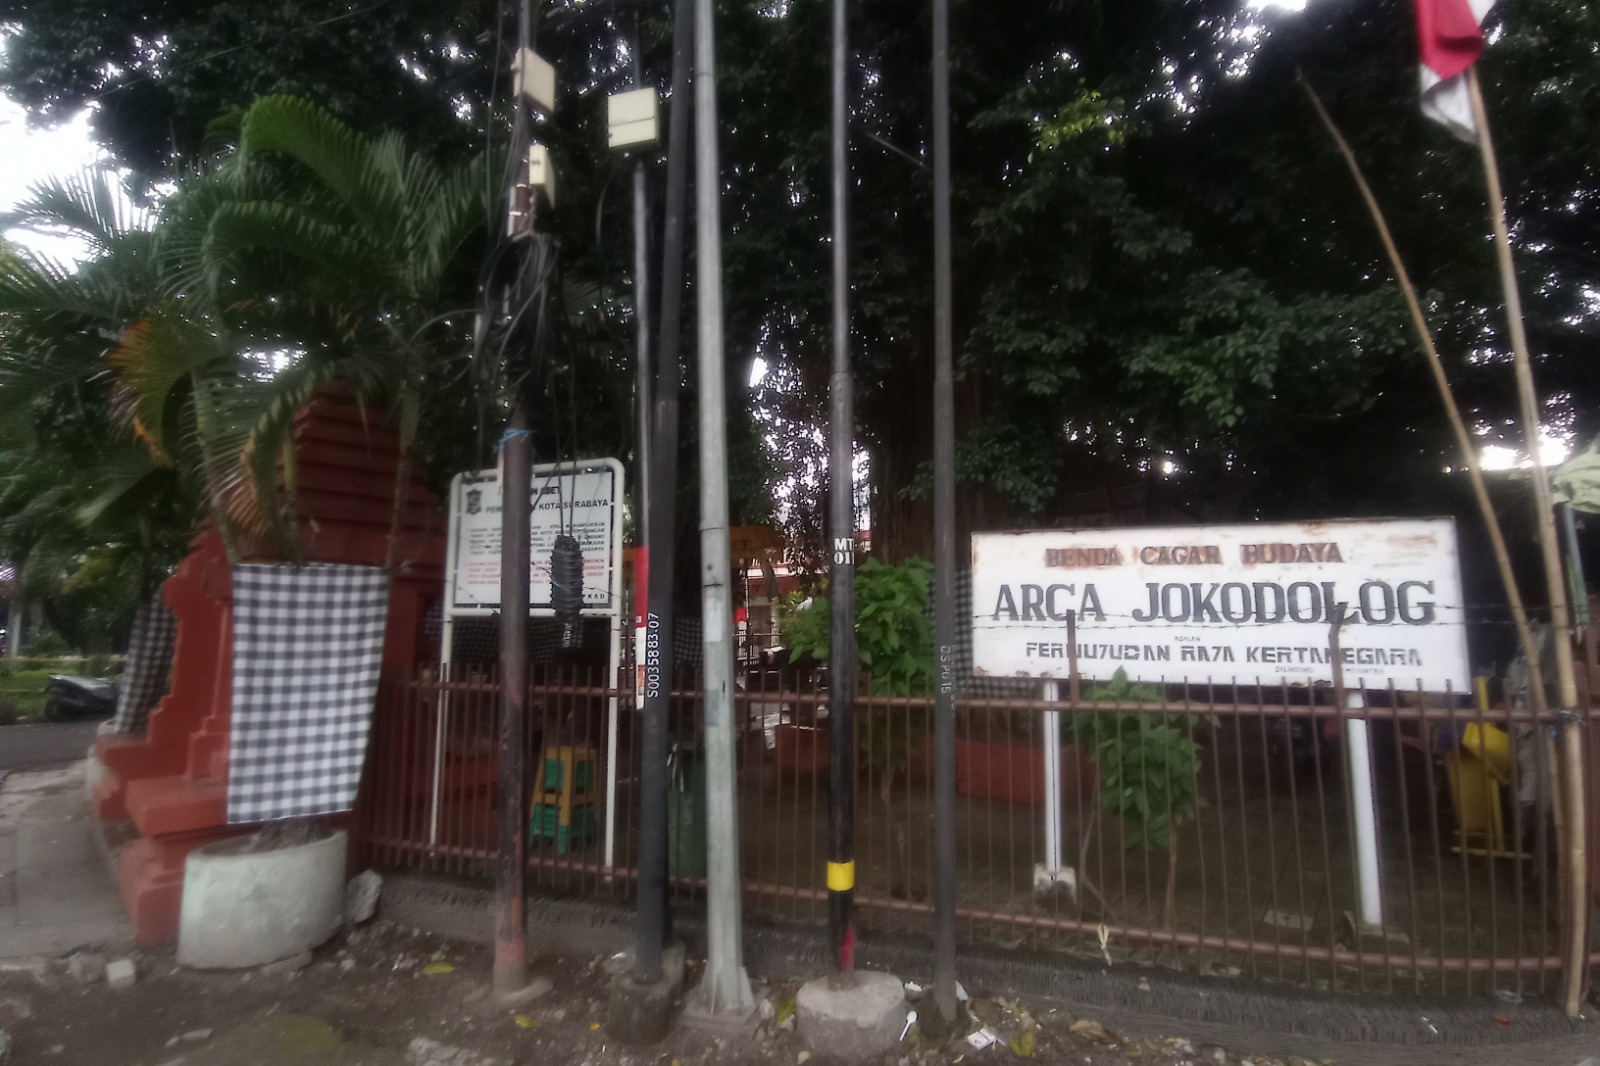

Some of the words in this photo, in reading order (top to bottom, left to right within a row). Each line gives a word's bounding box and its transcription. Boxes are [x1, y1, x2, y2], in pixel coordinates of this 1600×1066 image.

[539, 502, 560, 510] KOTA
[563, 499, 609, 509] SURABAYA
[1045, 547, 1122, 568] BENDA
[1140, 545, 1223, 566] CAGAR
[1240, 542, 1345, 564] BUDAYA
[992, 583, 1107, 622] ARCA
[1131, 580, 1437, 626] JOKODOLOG
[1180, 645, 1236, 662] RAJA
